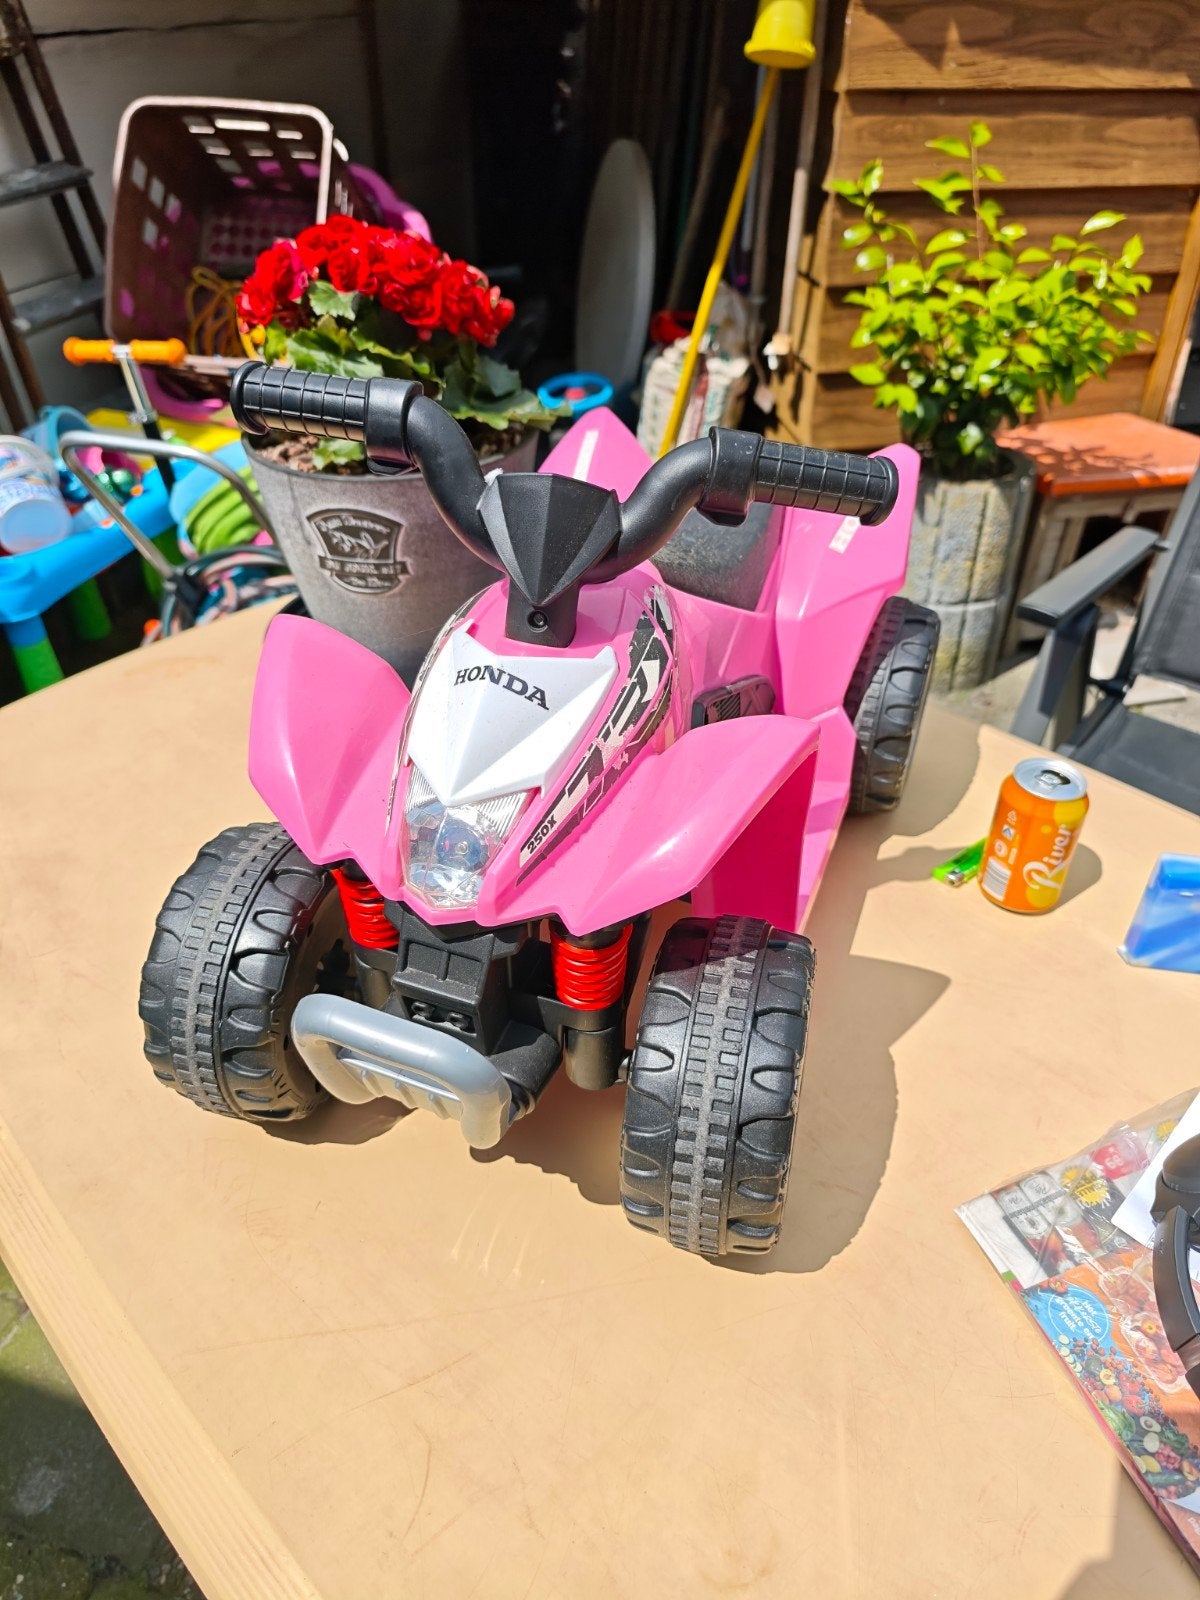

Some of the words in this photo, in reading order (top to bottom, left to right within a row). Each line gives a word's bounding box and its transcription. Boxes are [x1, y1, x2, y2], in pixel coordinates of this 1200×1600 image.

[453, 664, 550, 711] HONDA
[526, 814, 557, 854] 250X
[1022, 823, 1074, 890] River
[1054, 1296, 1084, 1327] groente
[1083, 1327, 1096, 1340] en
